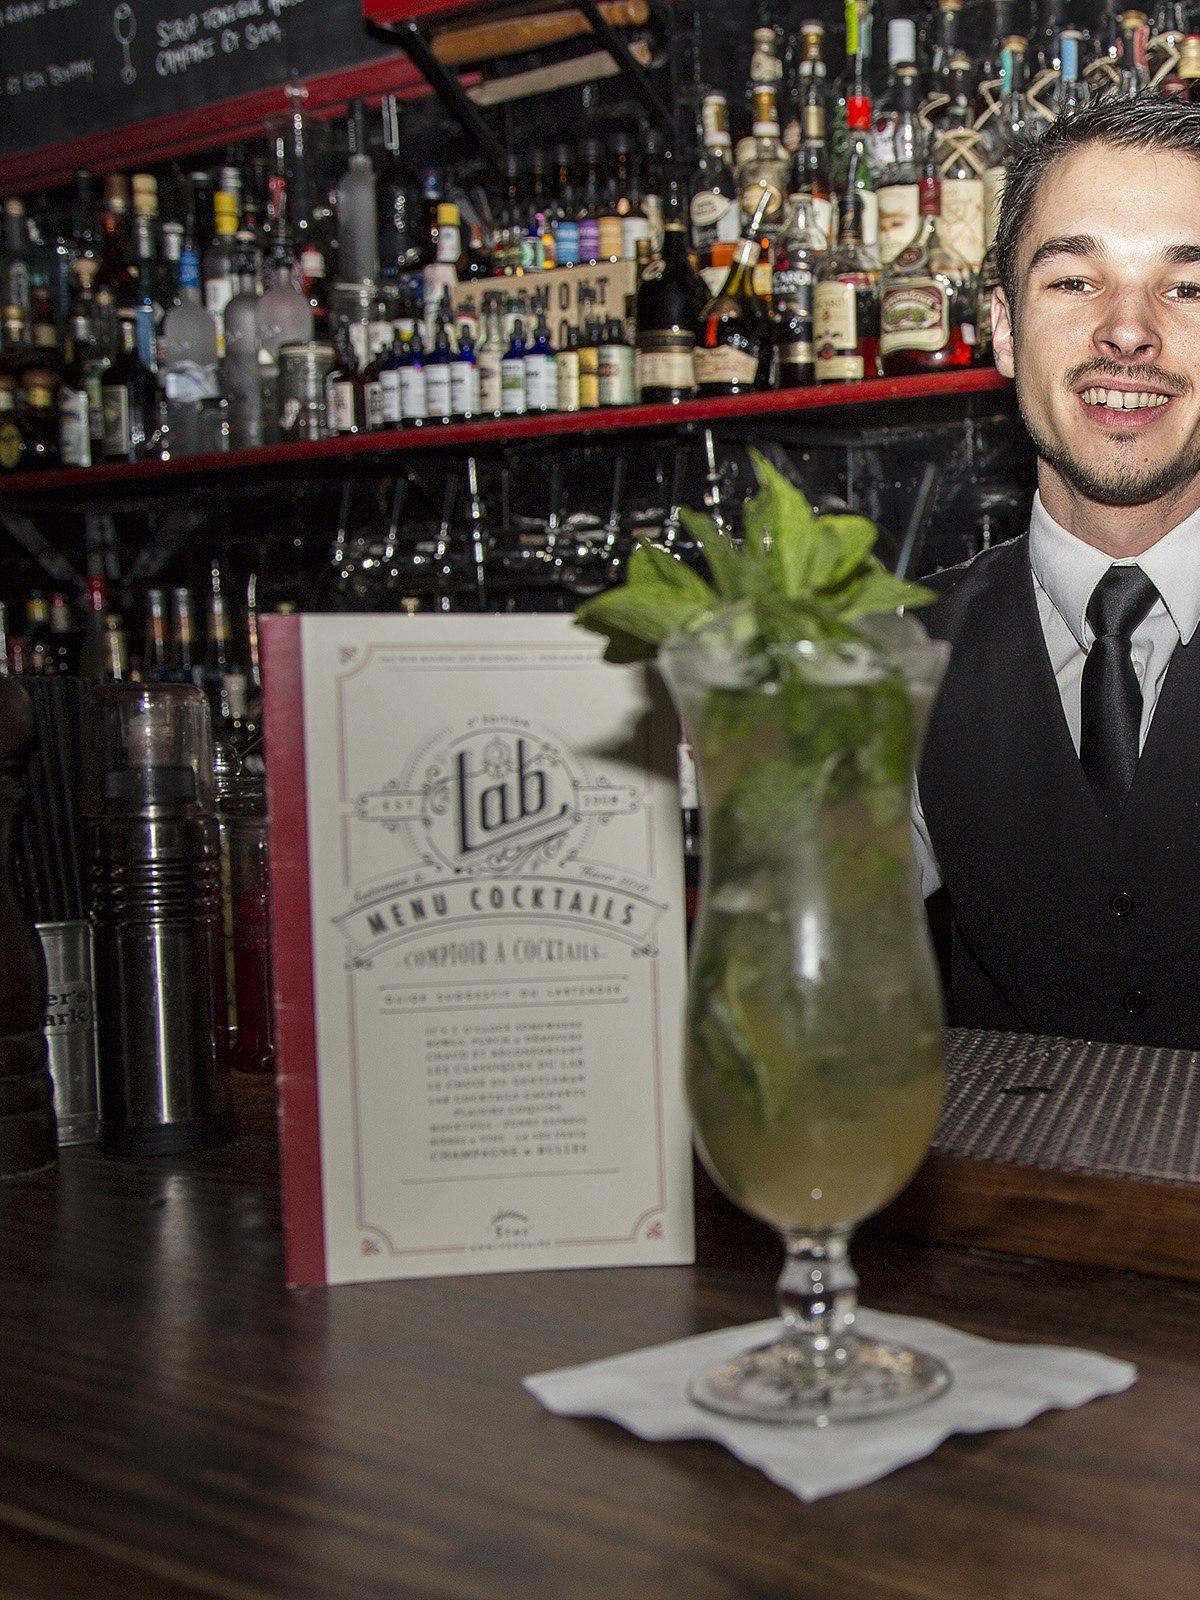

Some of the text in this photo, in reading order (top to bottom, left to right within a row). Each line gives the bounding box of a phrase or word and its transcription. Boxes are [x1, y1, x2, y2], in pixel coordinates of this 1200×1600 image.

[457, 737, 570, 856] Lab
[365, 885, 636, 936] MENU COCKTAILS
[403, 939, 487, 968] COMPTOIR
[513, 936, 600, 964] COCKTAILS
